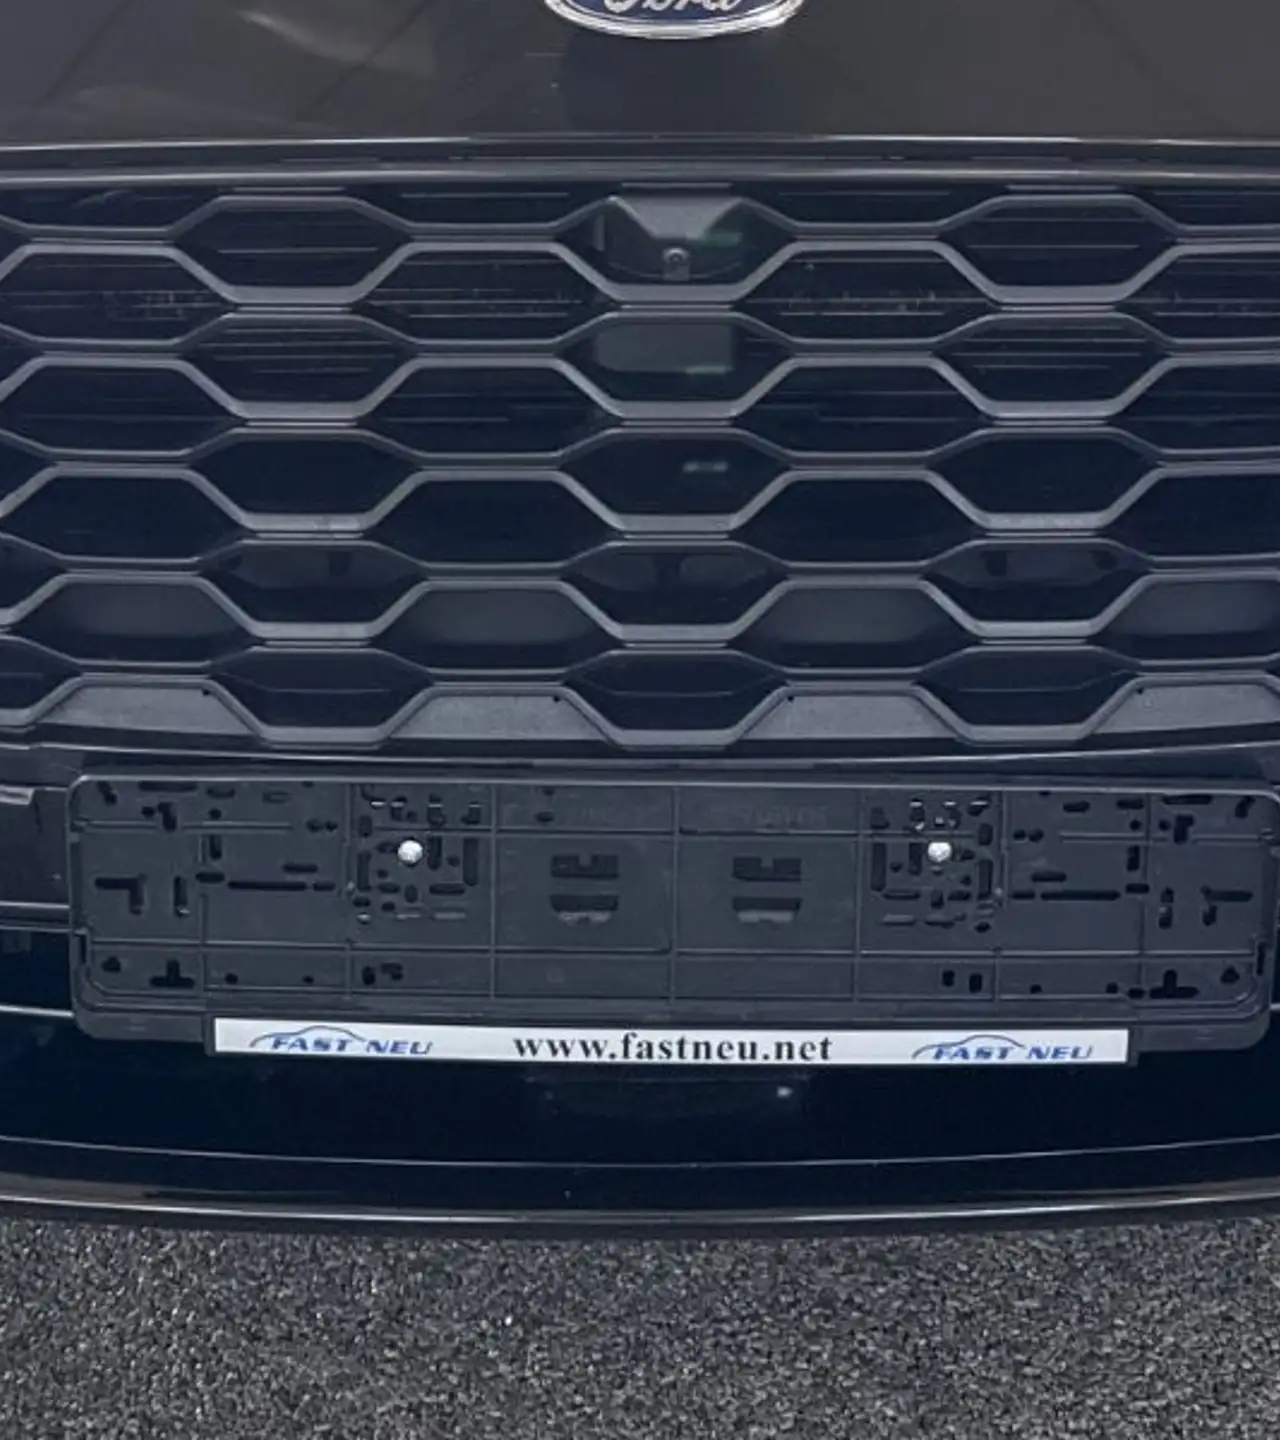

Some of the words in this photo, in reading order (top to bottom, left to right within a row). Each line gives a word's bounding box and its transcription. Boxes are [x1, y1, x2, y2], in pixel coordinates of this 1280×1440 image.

[271, 1037, 351, 1052] FAST
[365, 1039, 433, 1055] NEU
[513, 1032, 833, 1060] www.fastneu.net
[933, 1045, 1015, 1060] FAST
[1026, 1045, 1093, 1060] NEU
